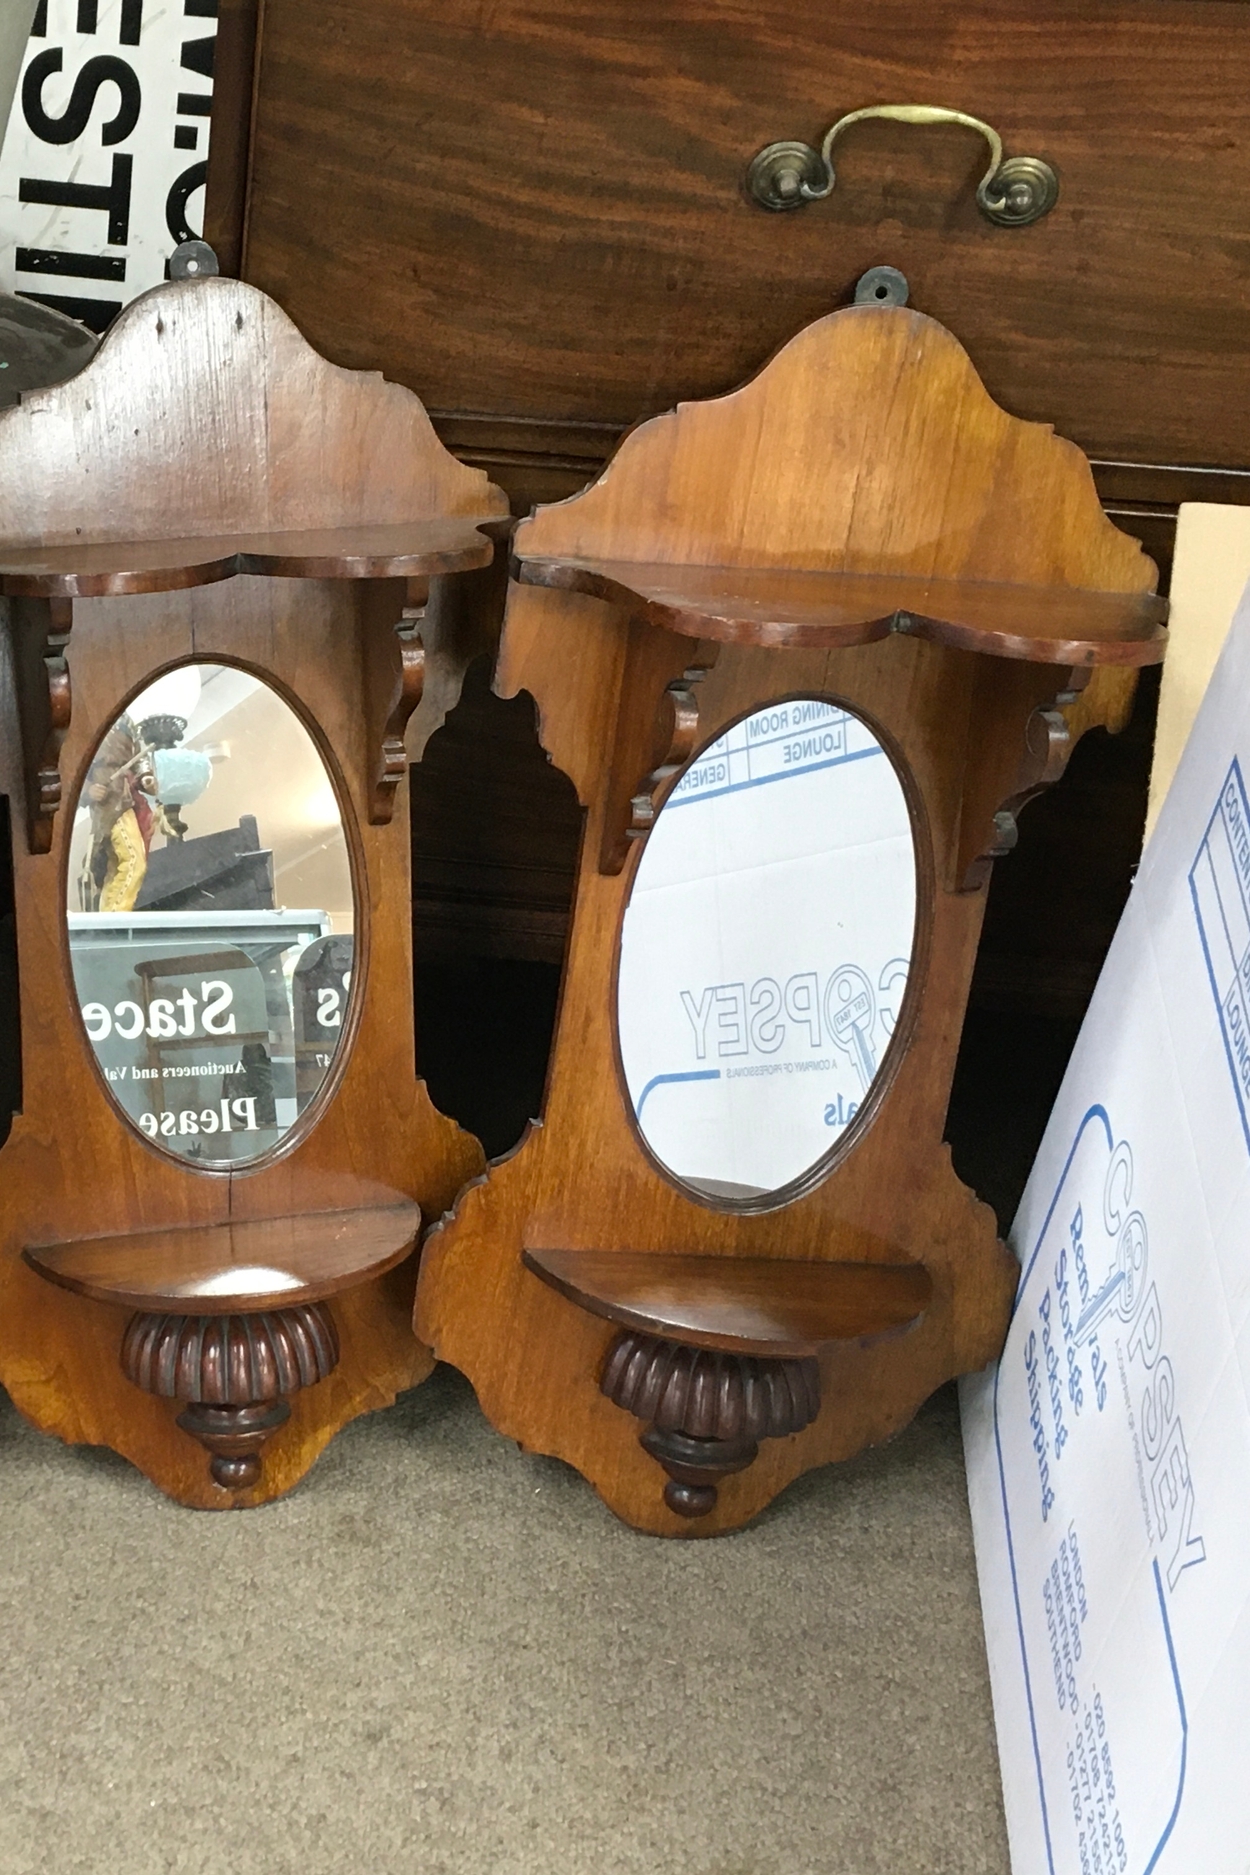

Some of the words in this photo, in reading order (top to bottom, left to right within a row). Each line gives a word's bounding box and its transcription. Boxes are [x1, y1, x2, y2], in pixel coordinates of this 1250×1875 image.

[1038, 1286, 1068, 1460] Packing
[1054, 1248, 1084, 1417] Storage
[1103, 1140, 1207, 1593] COPSEY
[1024, 1330, 1055, 1523] Shipping
[1043, 1577, 1066, 1711] SOUTHEND
[1051, 1557, 1079, 1716] BRENTWOOD
[1059, 1538, 1082, 1662] ROMFORD
[1068, 1518, 1088, 1623] LONDON
[1112, 1808, 1127, 1873] 1003
